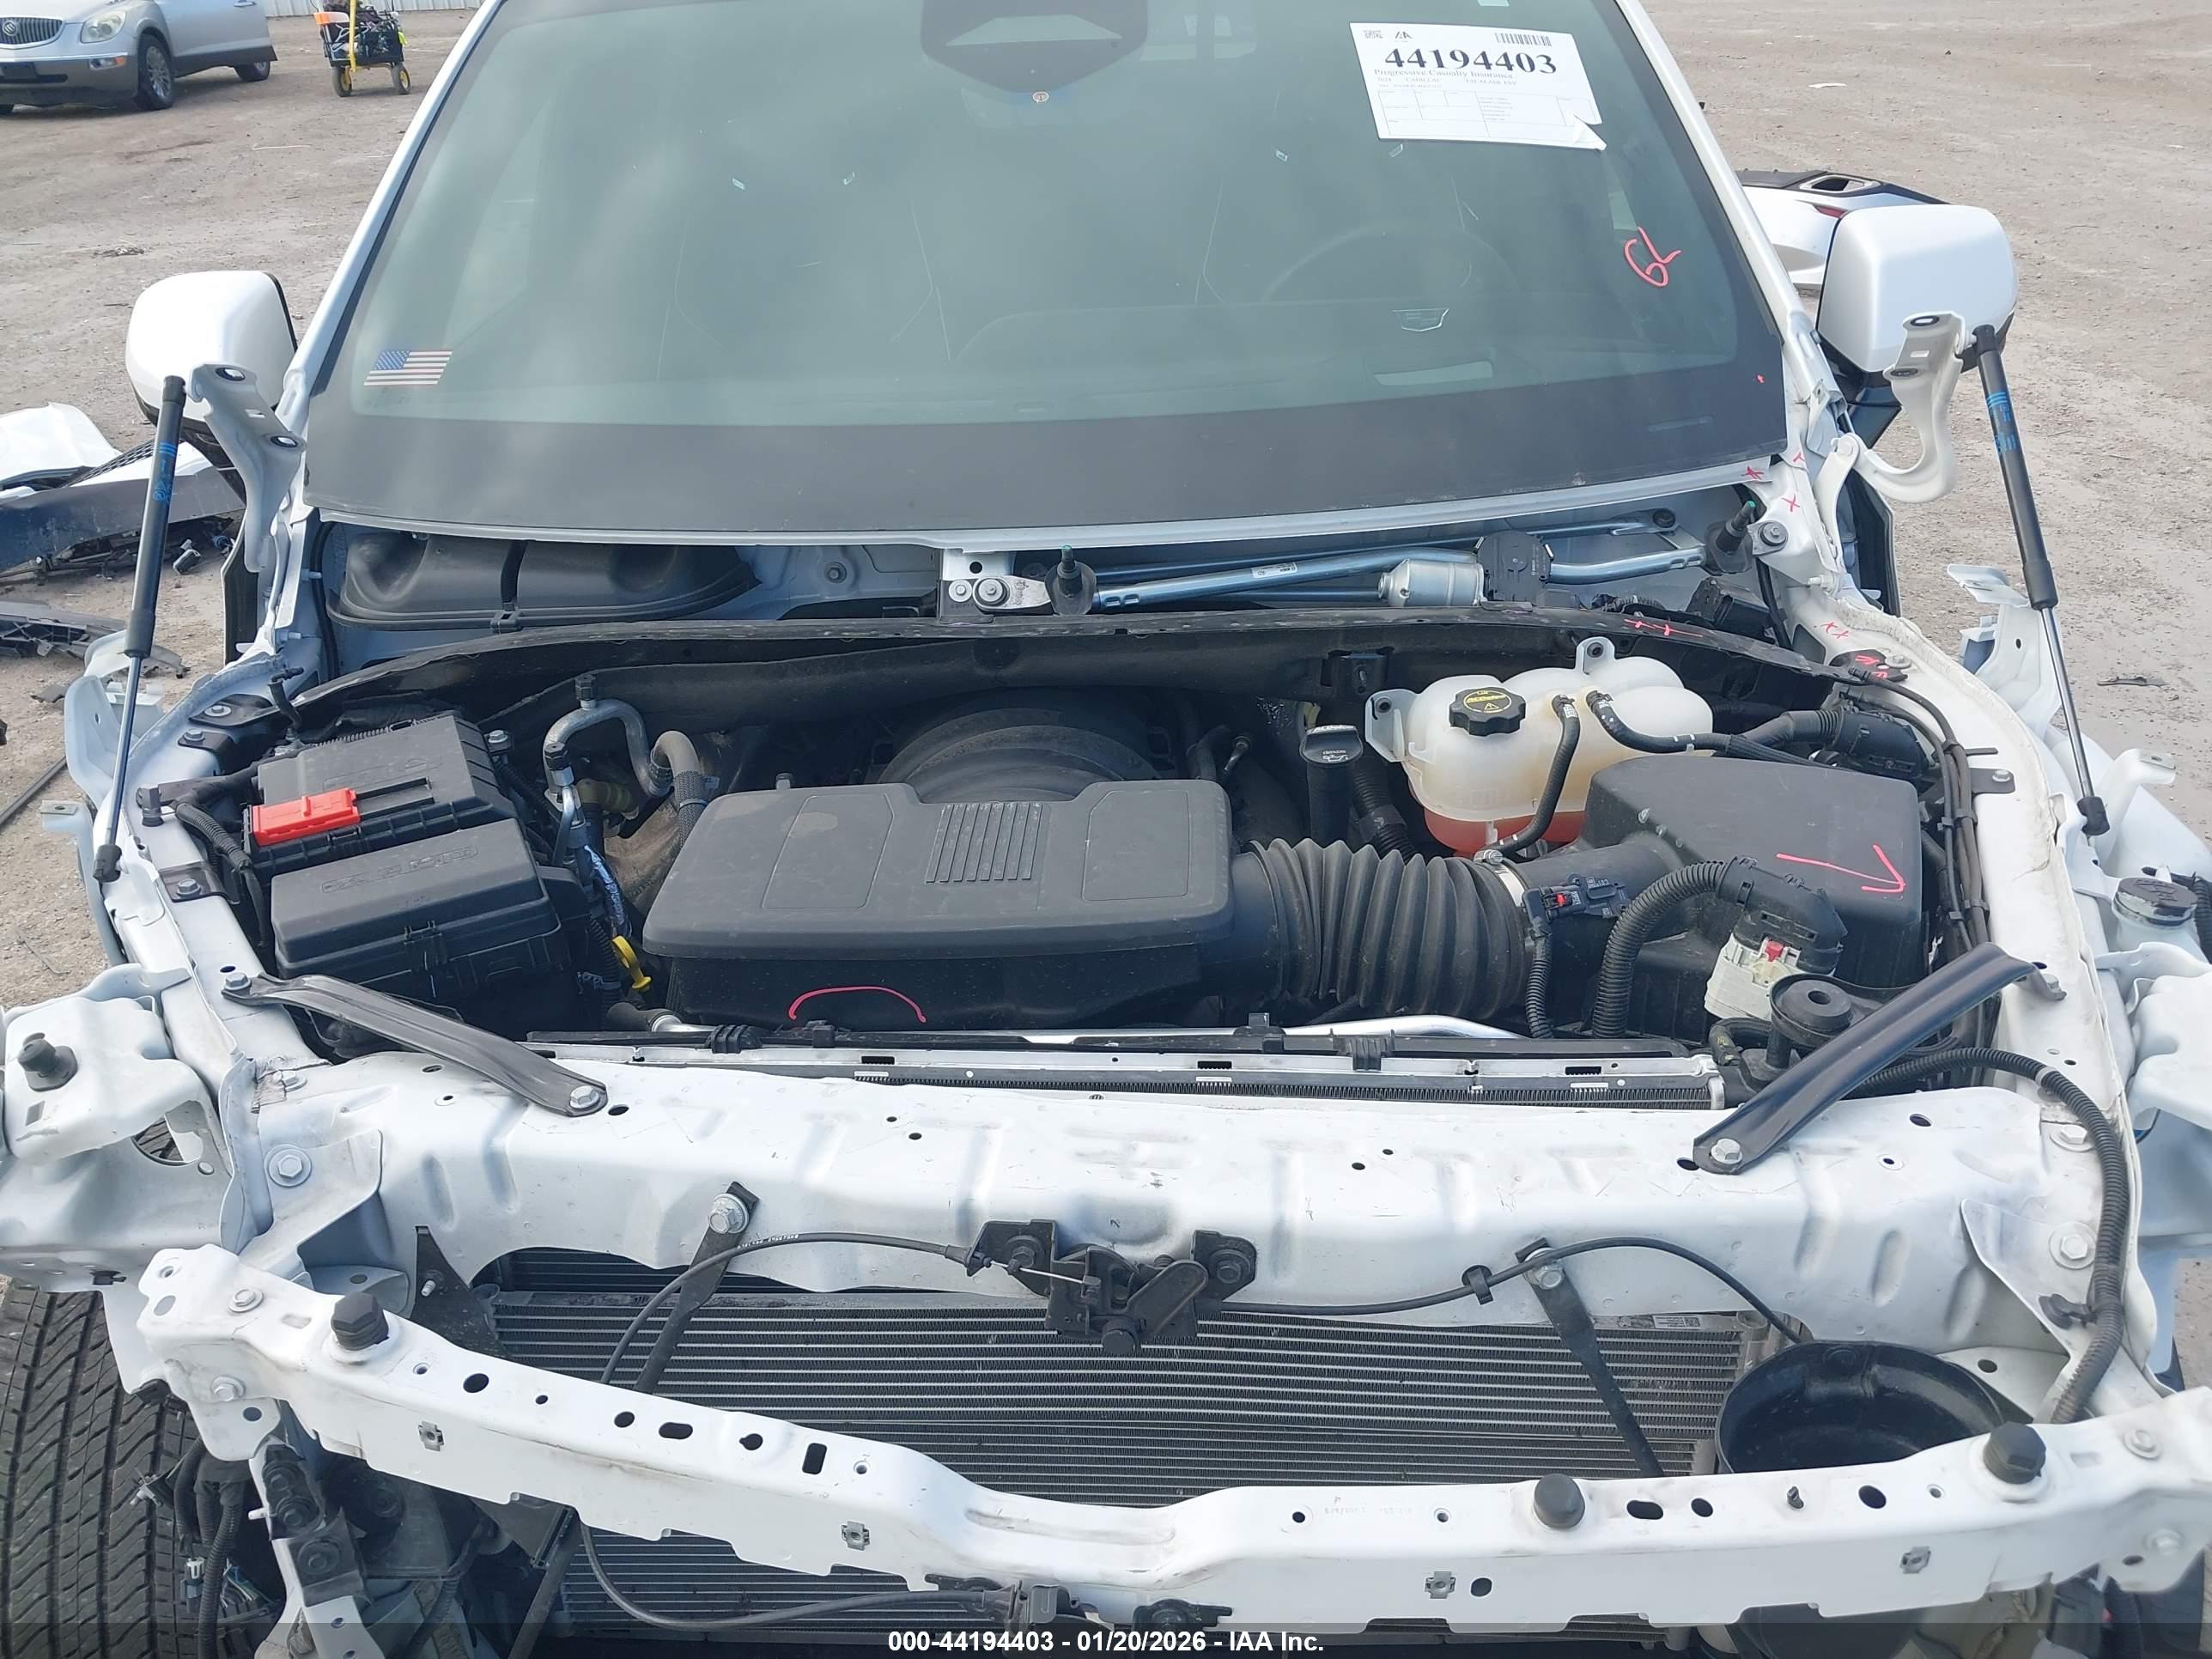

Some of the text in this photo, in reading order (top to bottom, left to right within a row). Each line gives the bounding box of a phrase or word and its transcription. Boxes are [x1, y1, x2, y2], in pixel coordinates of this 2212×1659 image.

[1384, 47, 1557, 75] 44194403
[1374, 68, 1514, 80] Progressive Casualty Insurance
